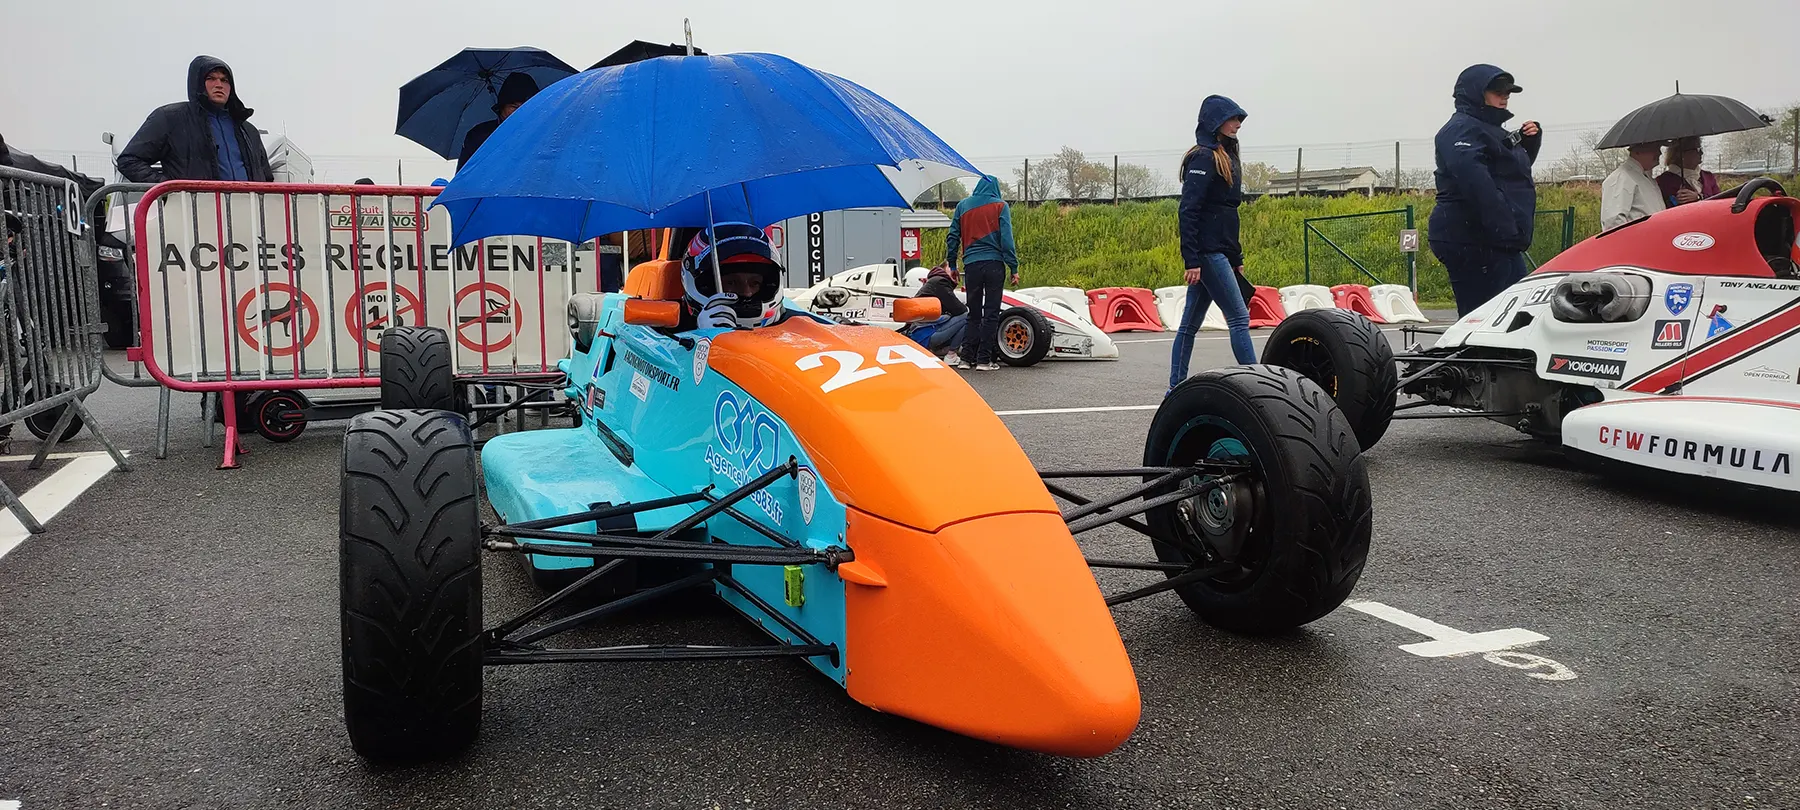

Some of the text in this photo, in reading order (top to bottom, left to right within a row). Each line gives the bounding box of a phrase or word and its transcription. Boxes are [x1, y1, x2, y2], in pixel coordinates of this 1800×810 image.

[68, 182, 78, 230] 6
[341, 205, 380, 214] Ccuit
[1402, 234, 1416, 246] P1
[1679, 235, 1706, 247] Ford
[367, 294, 401, 303] MOIS
[1491, 296, 1519, 328] 8
[1587, 340, 1629, 348] MOTORSPORT
[794, 344, 945, 394] 24
[1567, 360, 1620, 376] YOKOHAMA
